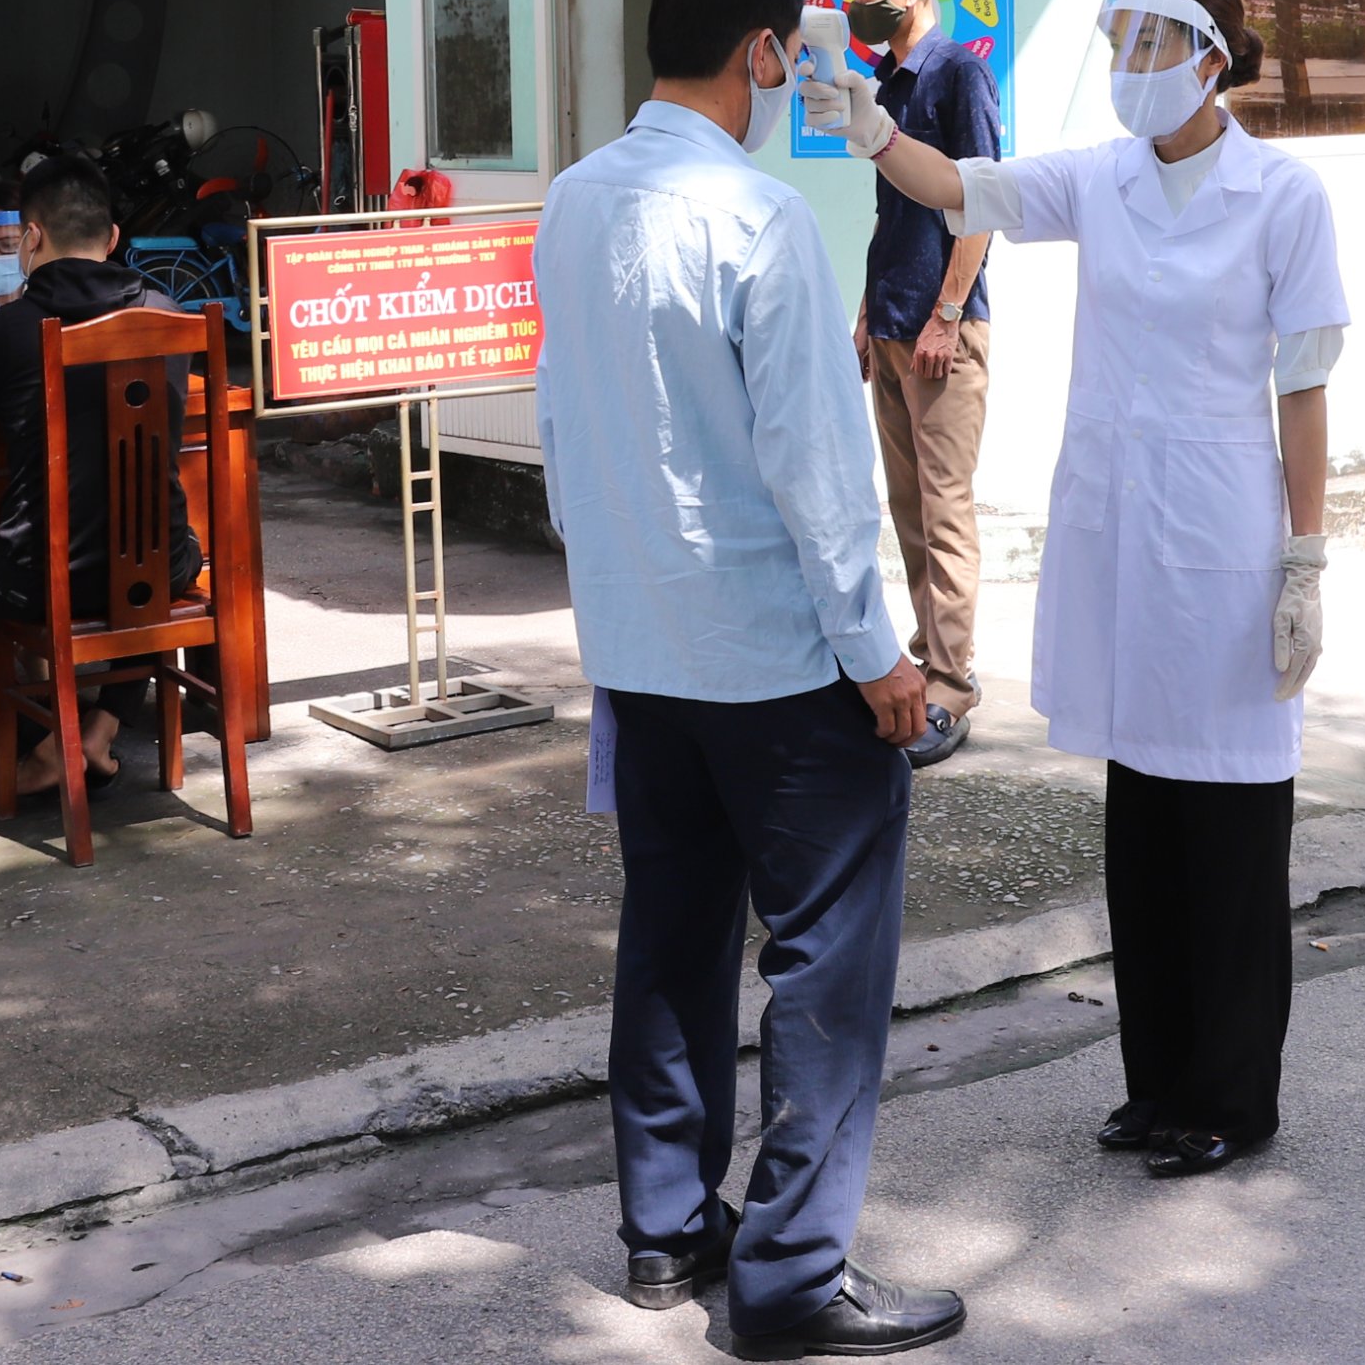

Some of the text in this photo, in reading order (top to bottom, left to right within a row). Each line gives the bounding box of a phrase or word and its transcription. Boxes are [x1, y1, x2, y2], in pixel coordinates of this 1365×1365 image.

[327, 263, 354, 274] CÔNG
[355, 261, 367, 272] TY
[396, 258, 413, 269] 1TV
[479, 251, 497, 262] TKV
[335, 248, 361, 260] CÔNG
[432, 240, 470, 253] KHOÁNG
[492, 236, 511, 248] VIỆT
[513, 235, 534, 246] NAM
[289, 271, 535, 328] CHỐT KIỂM DỊCH
[290, 339, 319, 360] YÊU
[355, 335, 384, 355] MỌI
[387, 330, 408, 351] CÁ
[409, 326, 451, 348] NHÂN
[453, 321, 509, 344] NGHIÊM
[510, 318, 537, 337] TÚC
[298, 342, 531, 385] THỰC HIỆN KHAI BÁO Y TẾ TẠI ĐÂY
